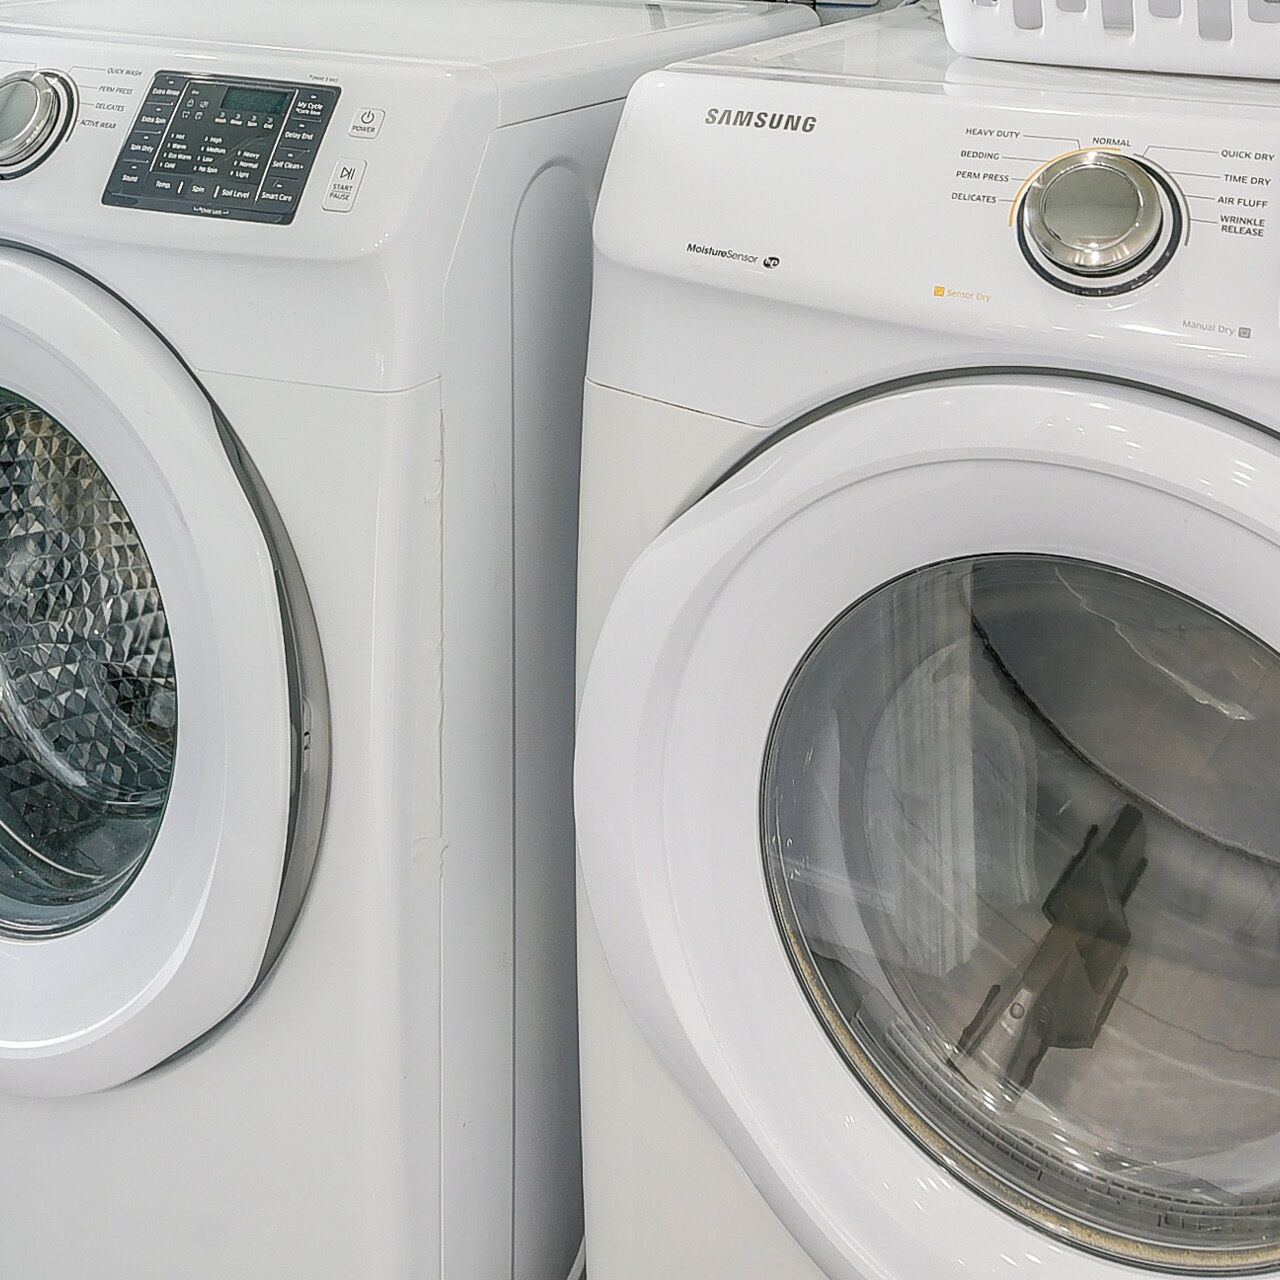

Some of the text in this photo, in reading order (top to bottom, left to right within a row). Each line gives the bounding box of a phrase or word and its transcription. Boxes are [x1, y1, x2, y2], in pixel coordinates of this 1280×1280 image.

[107, 67, 142, 77] QUICK WASH
[116, 87, 134, 95] PRESS
[95, 102, 126, 112] DELICATES
[296, 101, 323, 110] My Cycle
[80, 119, 117, 129] ACTIVE WEAR
[154, 116, 166, 124] Spin
[705, 108, 817, 133] SAMSUNG
[352, 125, 375, 133] POWER
[965, 128, 1020, 139] HEAVY DUTY
[285, 131, 314, 140] Delay End
[1092, 137, 1131, 147] NORMAL
[130, 143, 154, 153] Spin Only
[960, 150, 999, 161] BEDDING
[1221, 149, 1275, 161] QUICK DRY
[272, 160, 284, 168] Self
[122, 174, 139, 182] Sound
[955, 170, 1009, 182] PERM PRESS
[1223, 174, 1271, 186] TIME DRY
[192, 185, 205, 193] Spin
[333, 183, 353, 192] START
[233, 190, 250, 199] Level
[261, 192, 293, 202] Smart Care
[330, 192, 351, 200] PAUSE
[951, 192, 997, 204] DELICATES
[1217, 196, 1269, 208] AIR FLUFF
[1220, 215, 1265, 227] WRINKLE
[1221, 225, 1264, 237] RELEASE
[686, 243, 759, 264] MoistureSensor
[946, 289, 992, 303] Sensor Dry
[1182, 320, 1235, 337] Manual Dry
